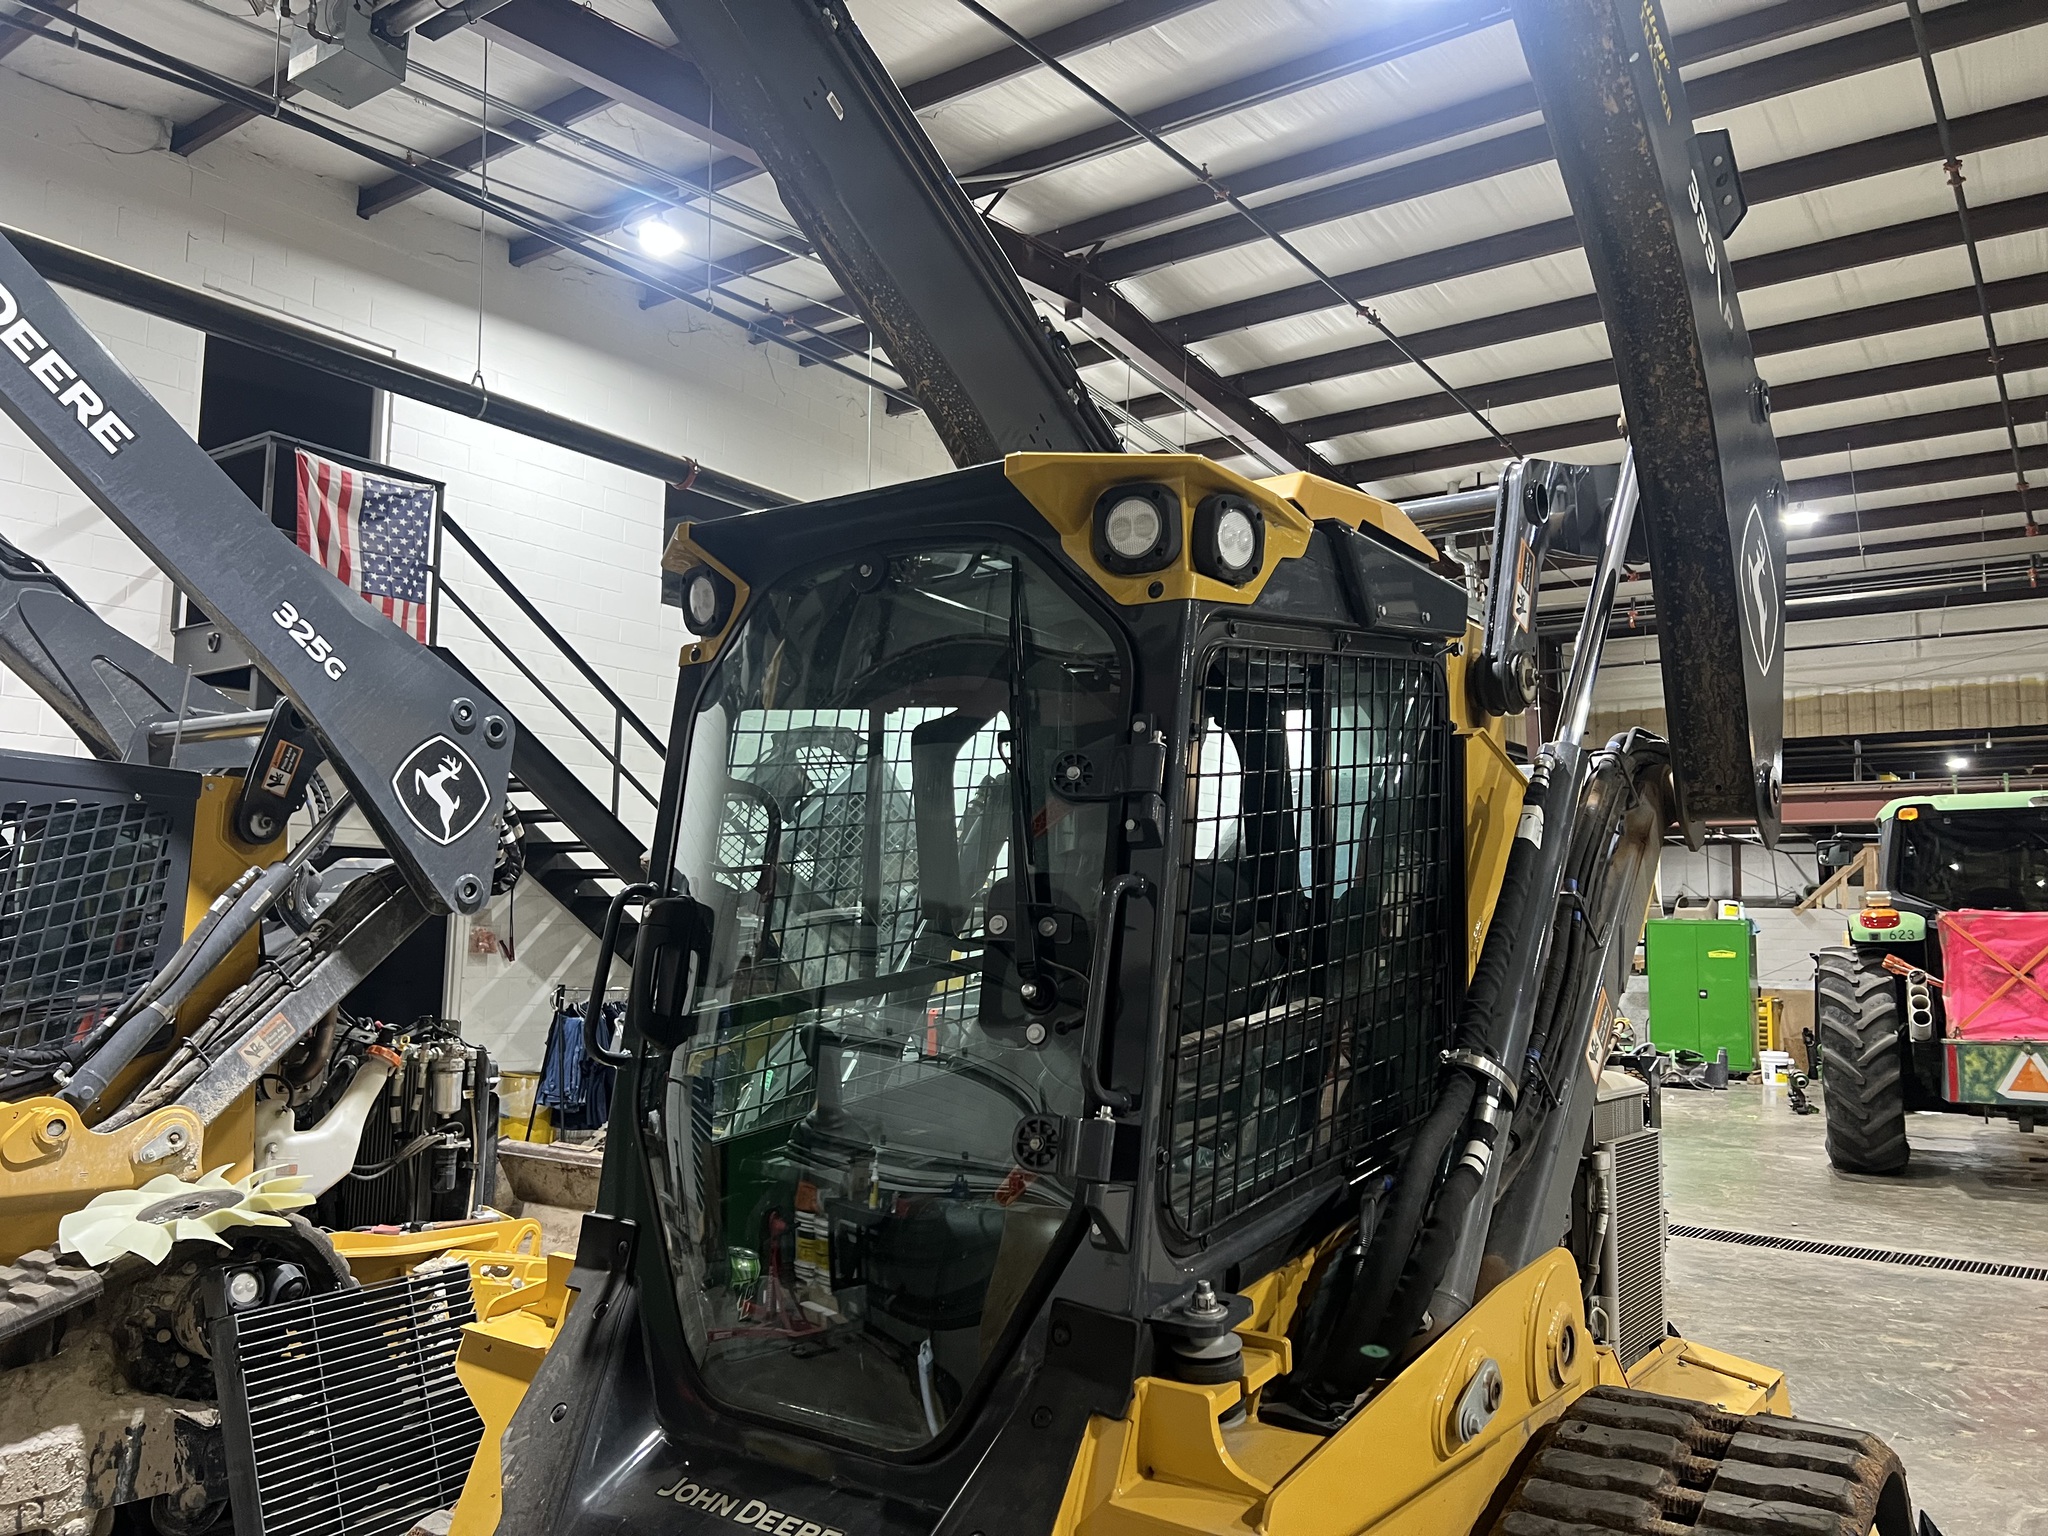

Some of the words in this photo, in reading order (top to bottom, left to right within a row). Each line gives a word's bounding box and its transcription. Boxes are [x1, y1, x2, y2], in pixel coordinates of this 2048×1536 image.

[1688, 168, 1716, 275] 333
[271, 600, 348, 681] 325G
[1889, 929, 1915, 940] 623
[656, 1476, 741, 1517] JOHN
